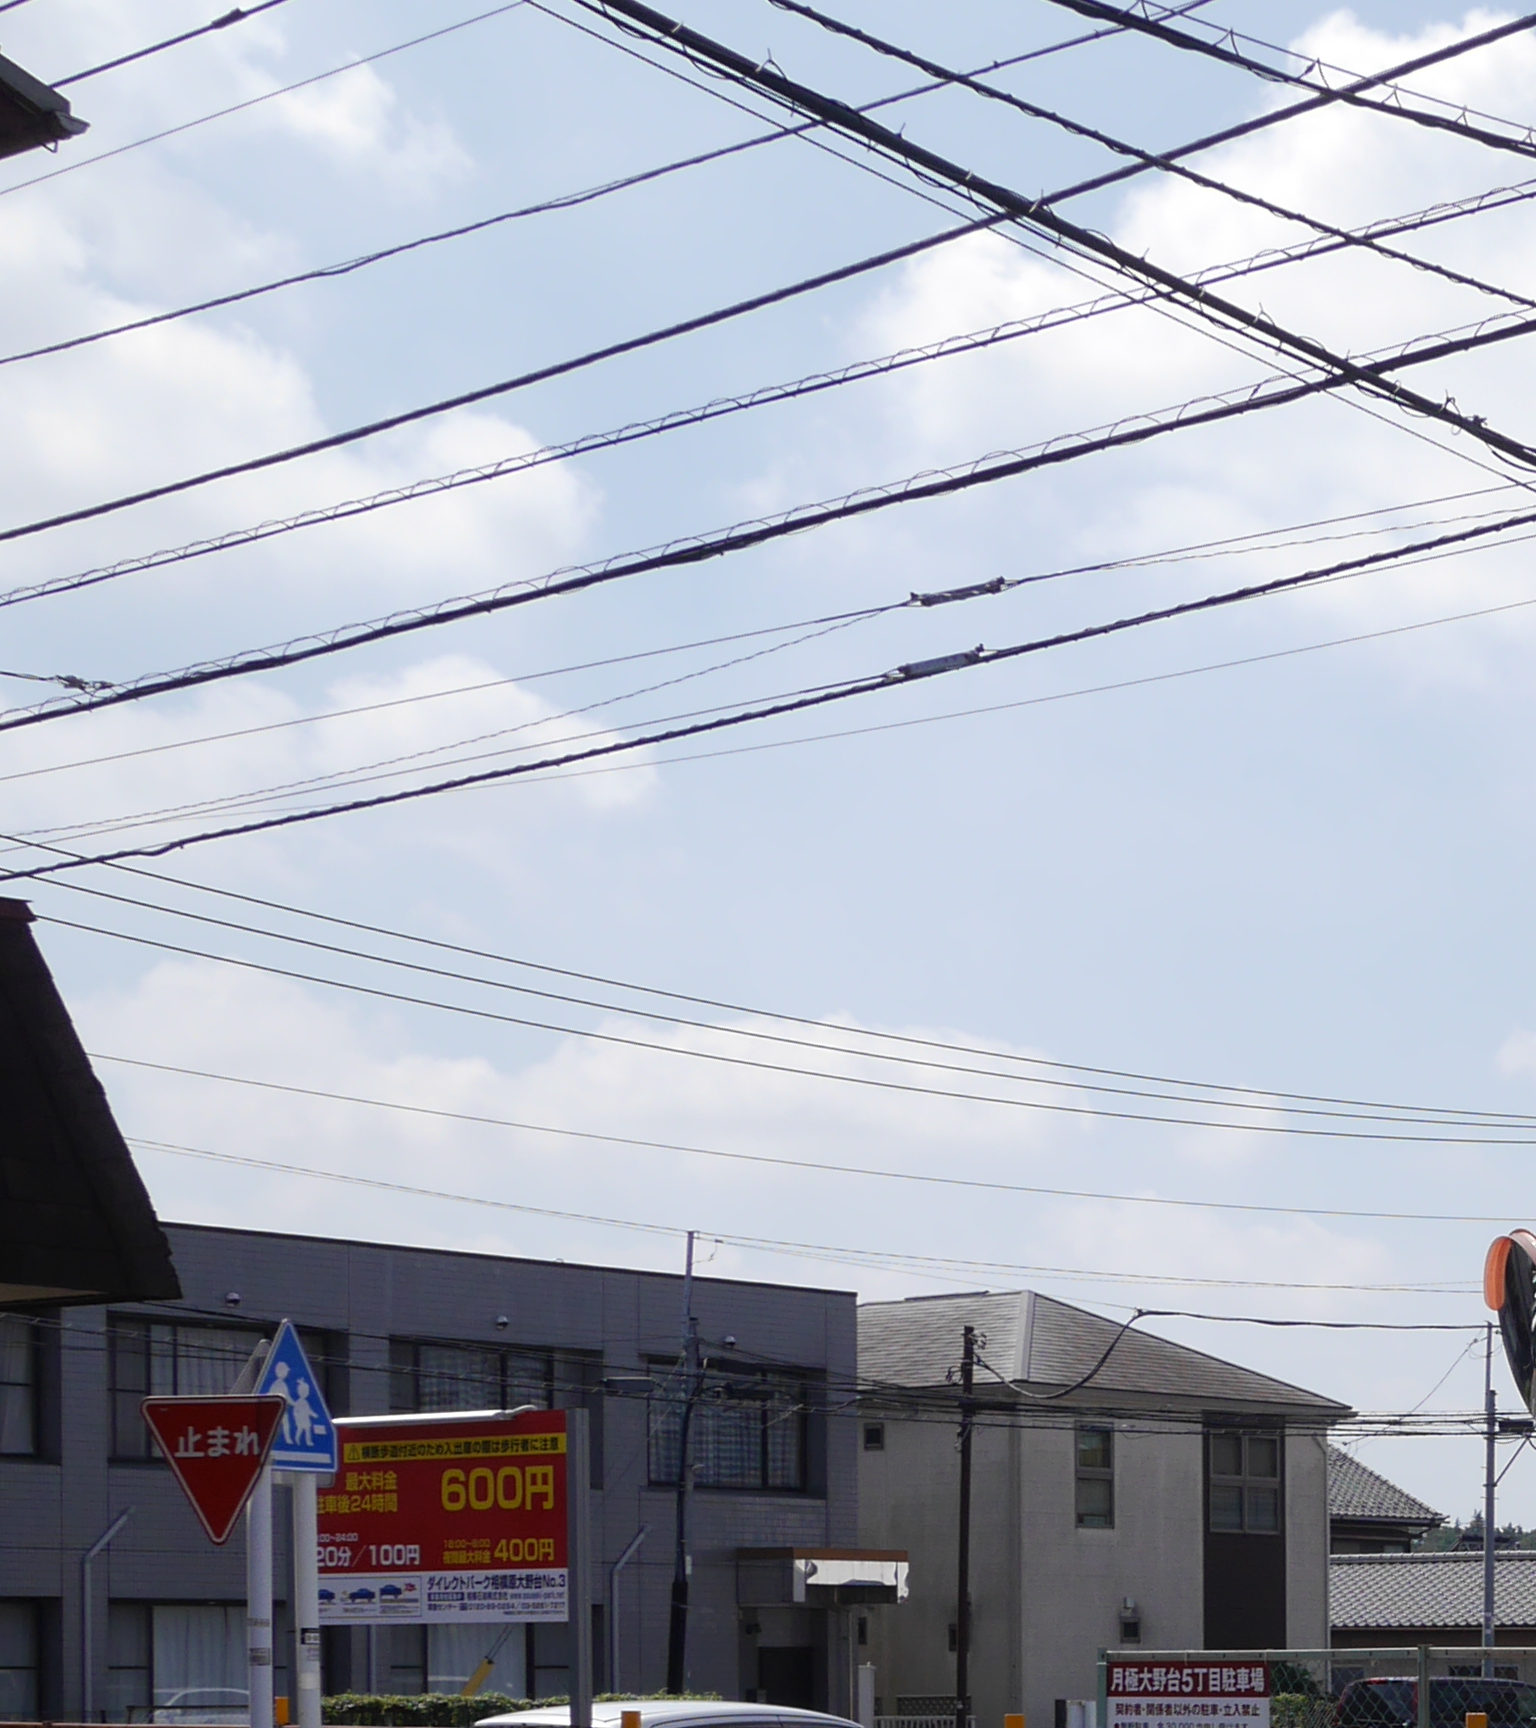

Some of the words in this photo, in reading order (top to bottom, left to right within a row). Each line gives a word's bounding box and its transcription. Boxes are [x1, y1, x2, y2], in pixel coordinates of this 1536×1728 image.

[174, 1425, 260, 1458] 止まれ
[345, 1471, 398, 1492] 最大料金
[440, 1465, 554, 1511] 600円
[493, 1538, 554, 1562] 400円
[1111, 1667, 1265, 1692] 月極大野台5丁目駐車場
